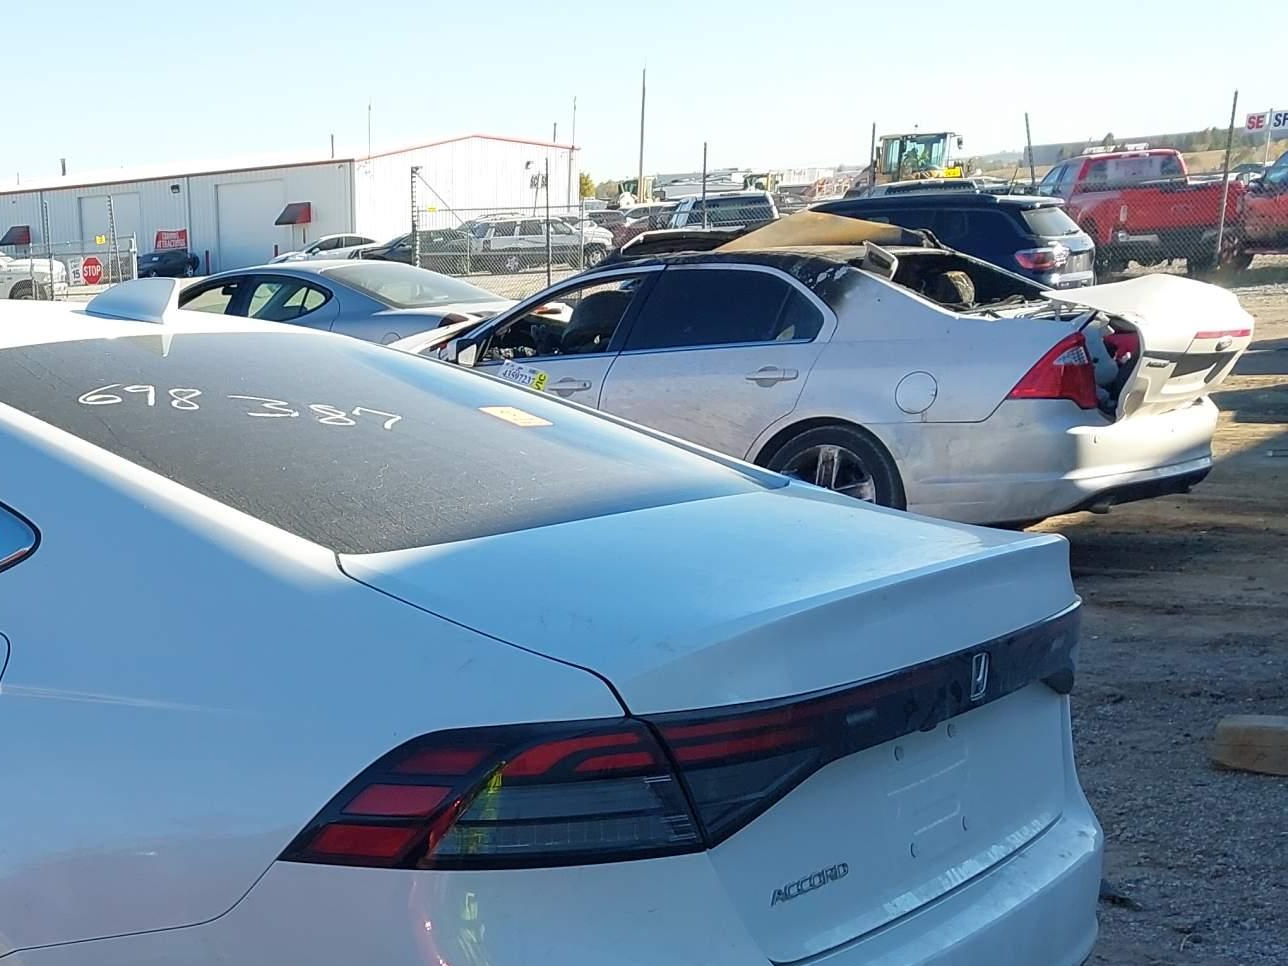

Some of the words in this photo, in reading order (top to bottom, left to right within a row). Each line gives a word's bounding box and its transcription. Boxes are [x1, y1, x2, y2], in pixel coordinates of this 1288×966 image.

[72, 269, 81, 279] 15
[83, 265, 101, 277] STOP
[770, 863, 849, 907] ACCORD
